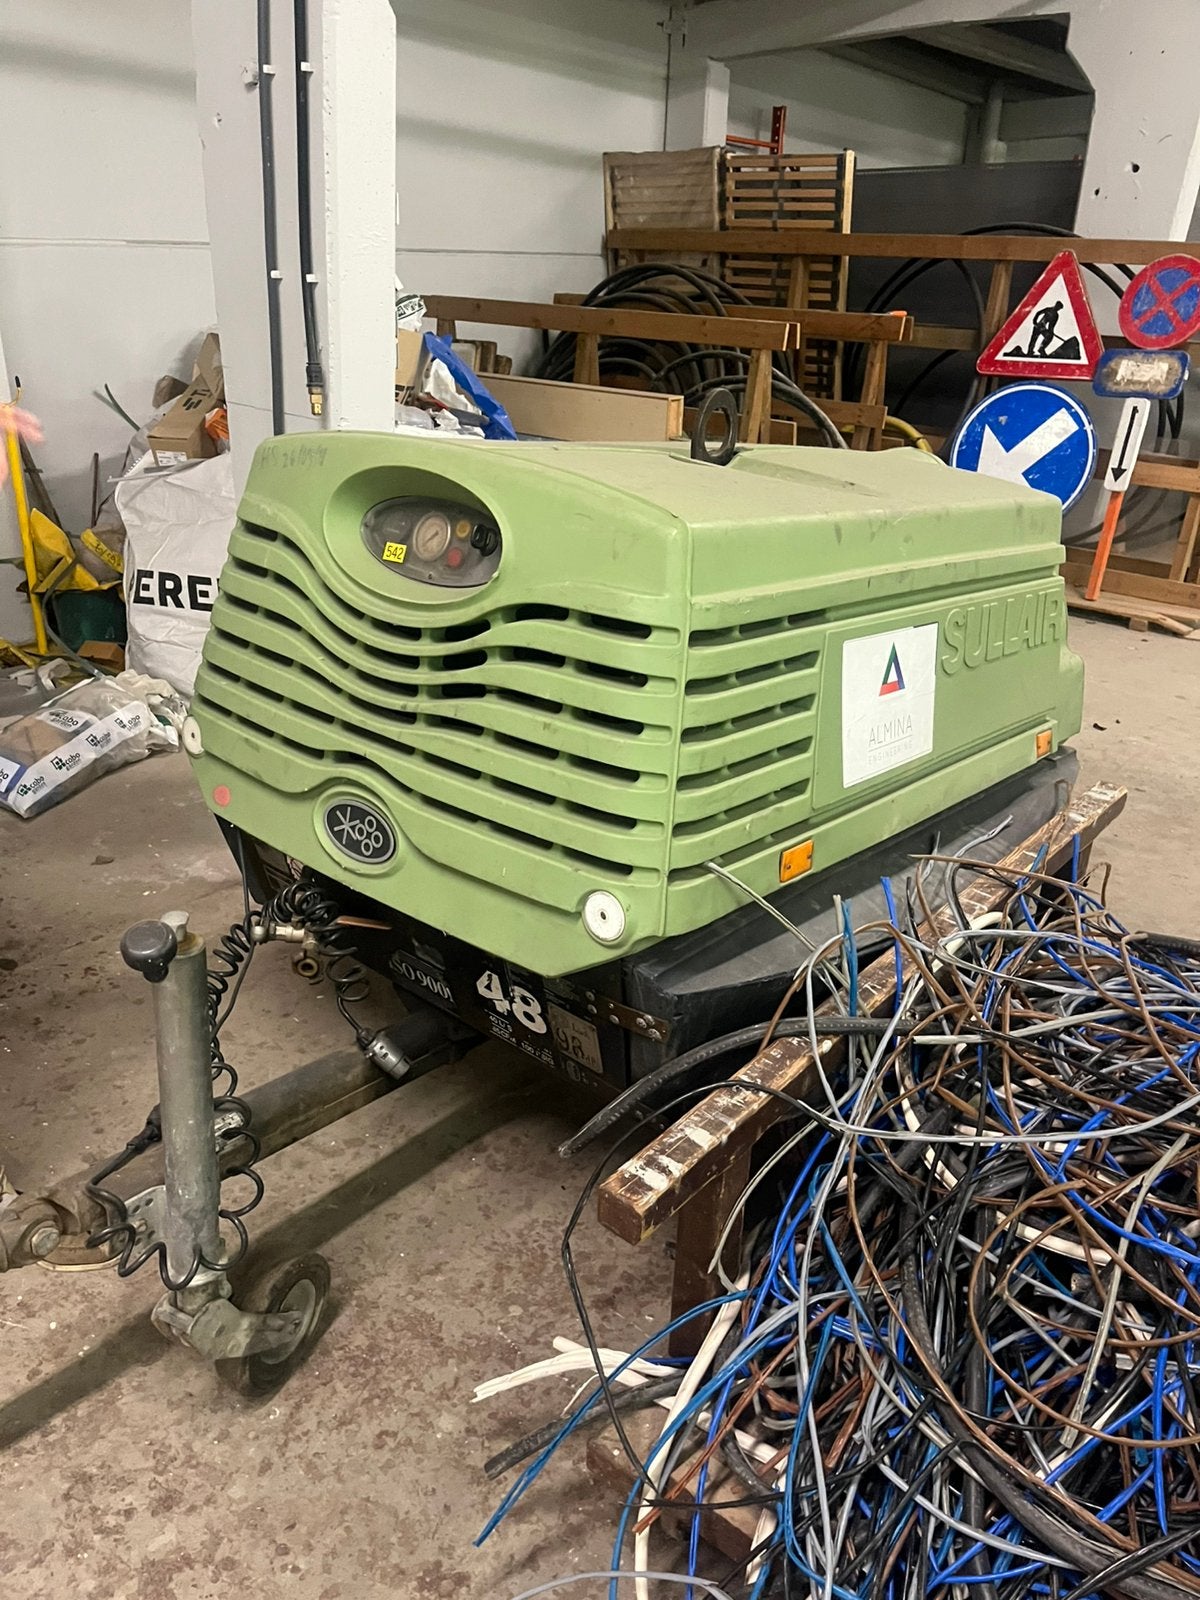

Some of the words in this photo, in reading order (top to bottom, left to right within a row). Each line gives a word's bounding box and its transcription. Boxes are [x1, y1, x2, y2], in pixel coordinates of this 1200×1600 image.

[385, 545, 405, 560] 542
[133, 569, 220, 612] ERE
[941, 589, 1062, 676] SULLAIR
[868, 714, 913, 747] ALMINA
[65, 752, 81, 765] cobo
[30, 776, 45, 789] cobo
[416, 969, 455, 1003] 9001
[476, 970, 547, 1034] 48
